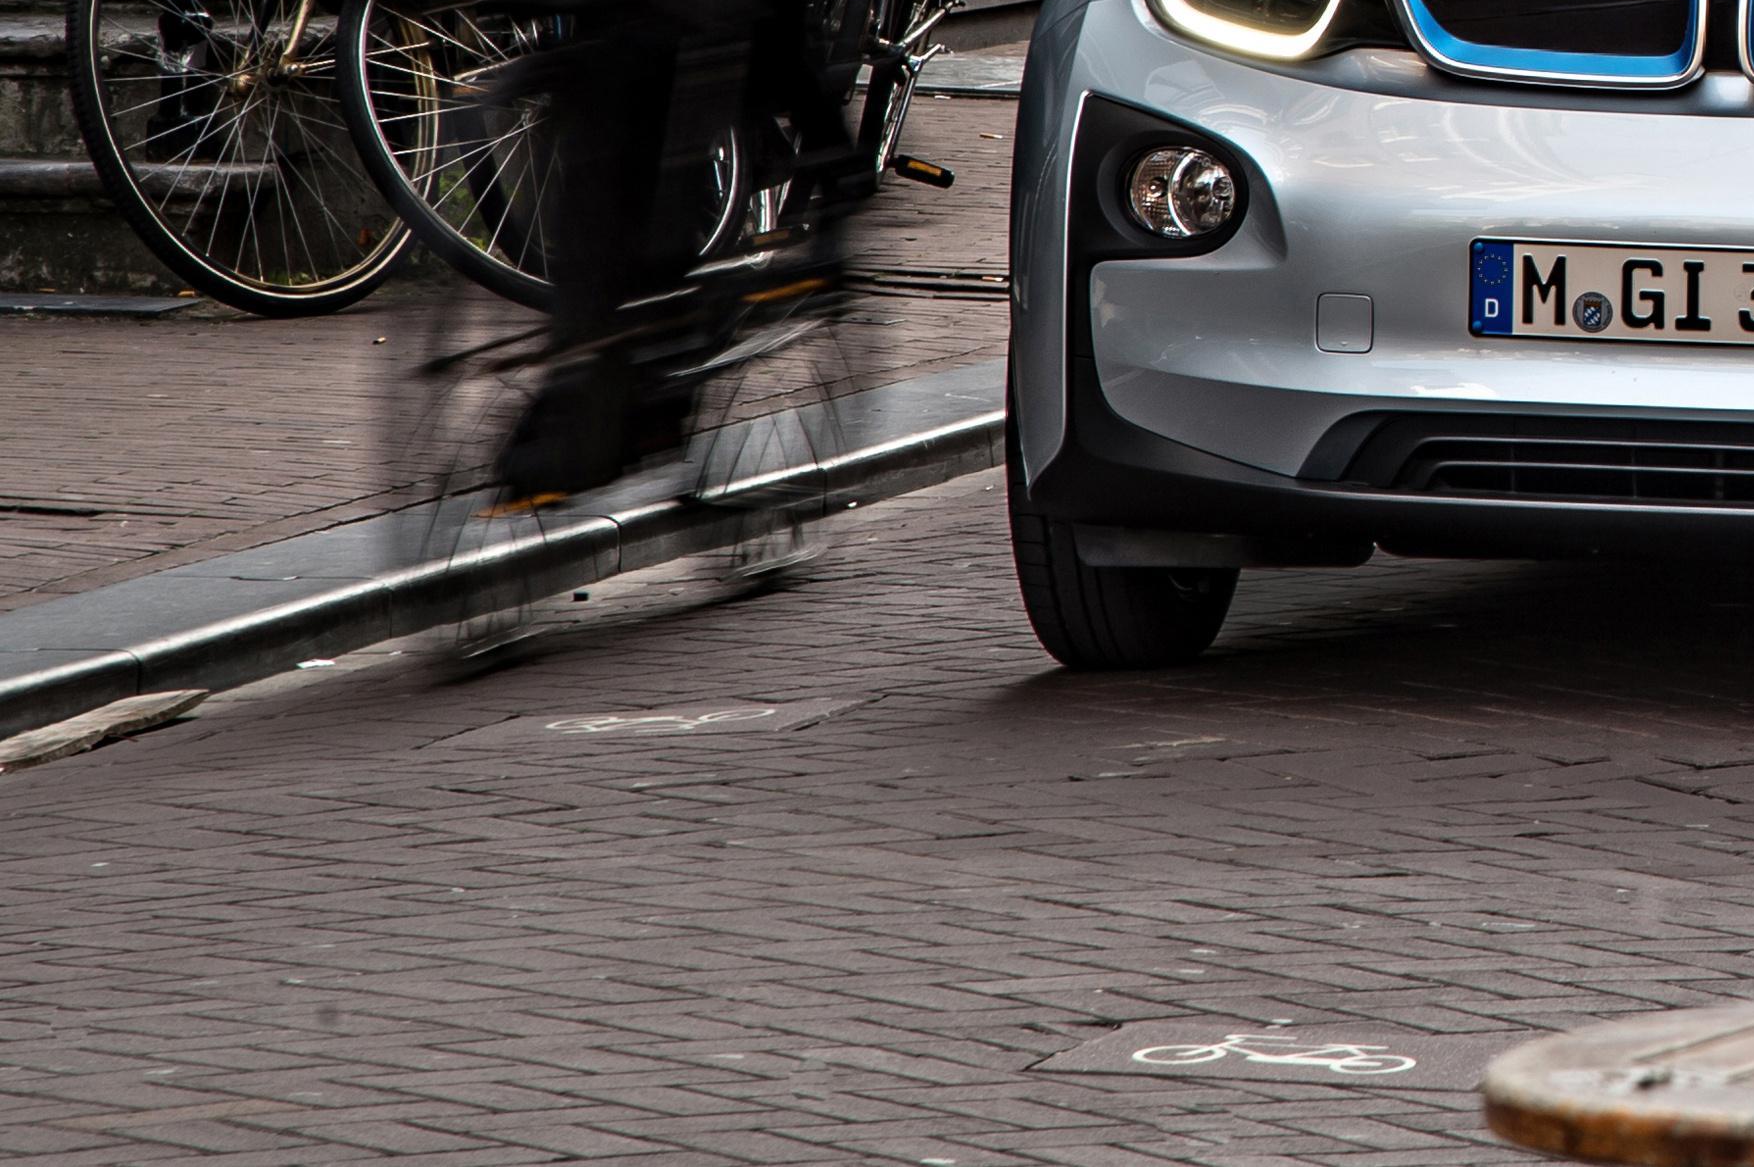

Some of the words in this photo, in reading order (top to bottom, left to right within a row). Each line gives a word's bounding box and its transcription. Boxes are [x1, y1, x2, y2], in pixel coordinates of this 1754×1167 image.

[1485, 298, 1499, 319] D
[1522, 254, 1567, 326] M
[1622, 259, 1712, 332] GI
